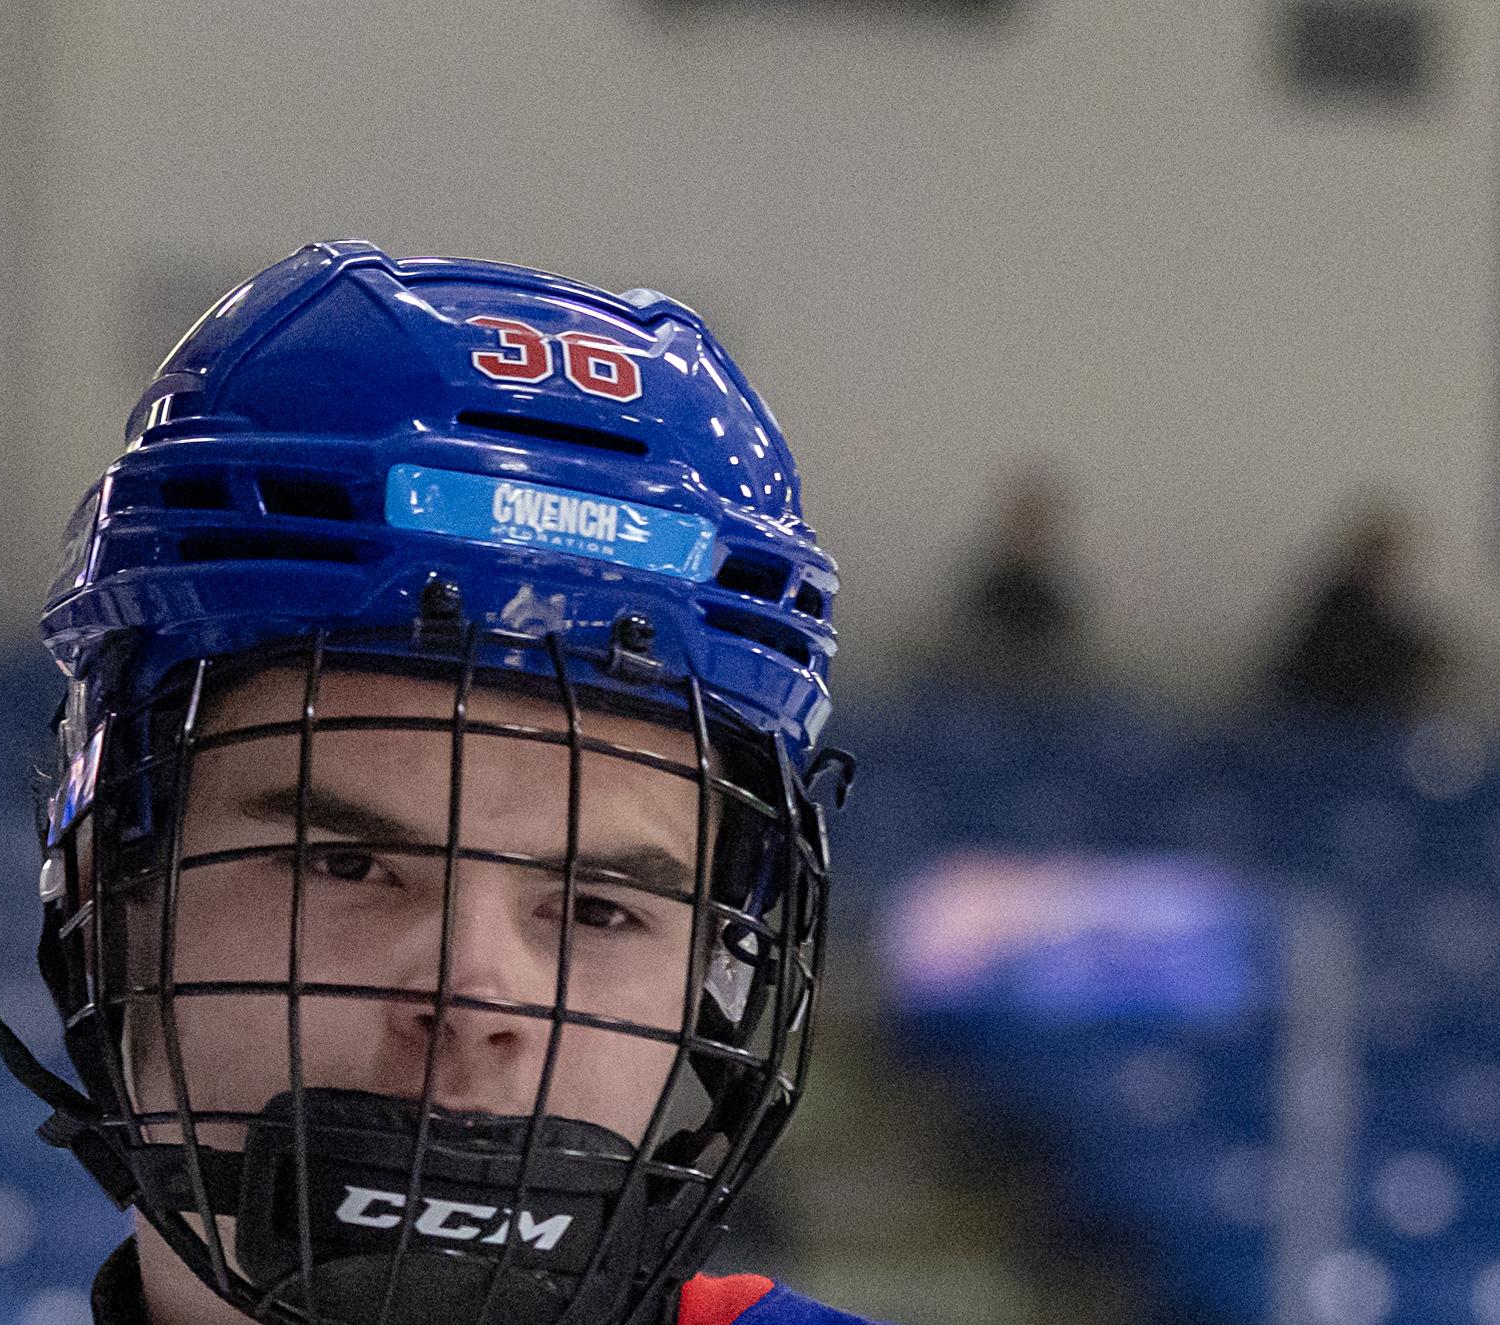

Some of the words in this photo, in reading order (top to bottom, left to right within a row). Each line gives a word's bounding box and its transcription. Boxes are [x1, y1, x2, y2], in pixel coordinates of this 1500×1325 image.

[464, 315, 643, 403] 36
[491, 482, 619, 543] CWENCH
[335, 1185, 575, 1252] CCM
